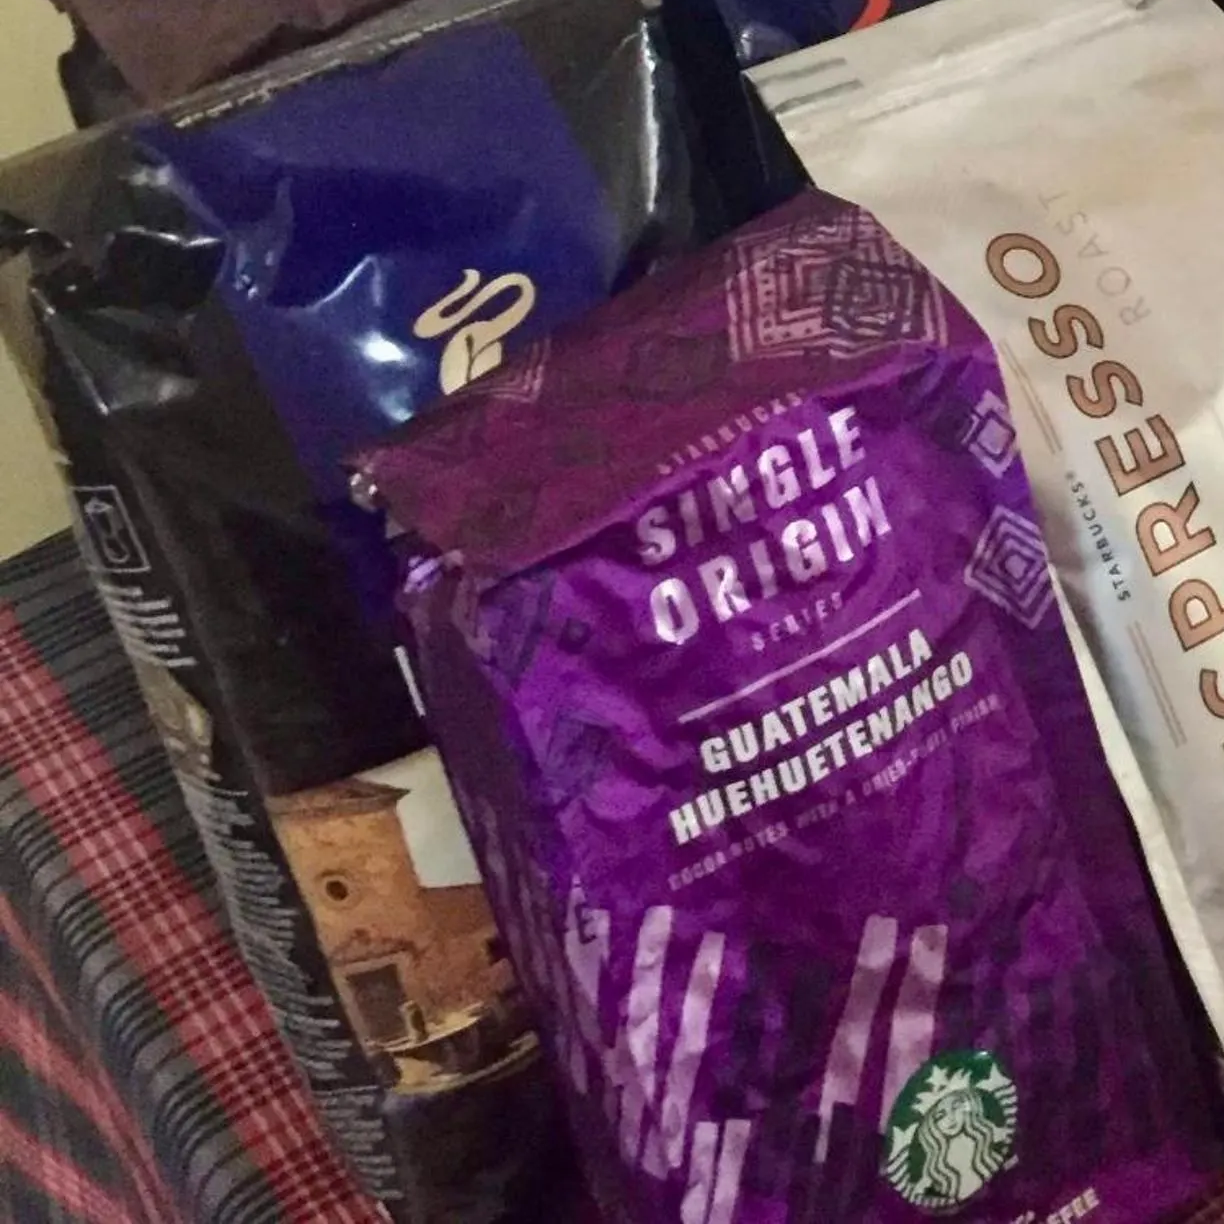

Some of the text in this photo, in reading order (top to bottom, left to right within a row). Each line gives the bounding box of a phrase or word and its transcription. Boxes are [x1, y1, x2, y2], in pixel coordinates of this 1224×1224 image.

[1037, 189, 1153, 326] ROAST
[634, 405, 867, 567] SINGLE
[648, 475, 892, 646] ORIGIN
[668, 650, 975, 847] HUEHUETENANGO
[699, 626, 934, 776] GUATEMALA
